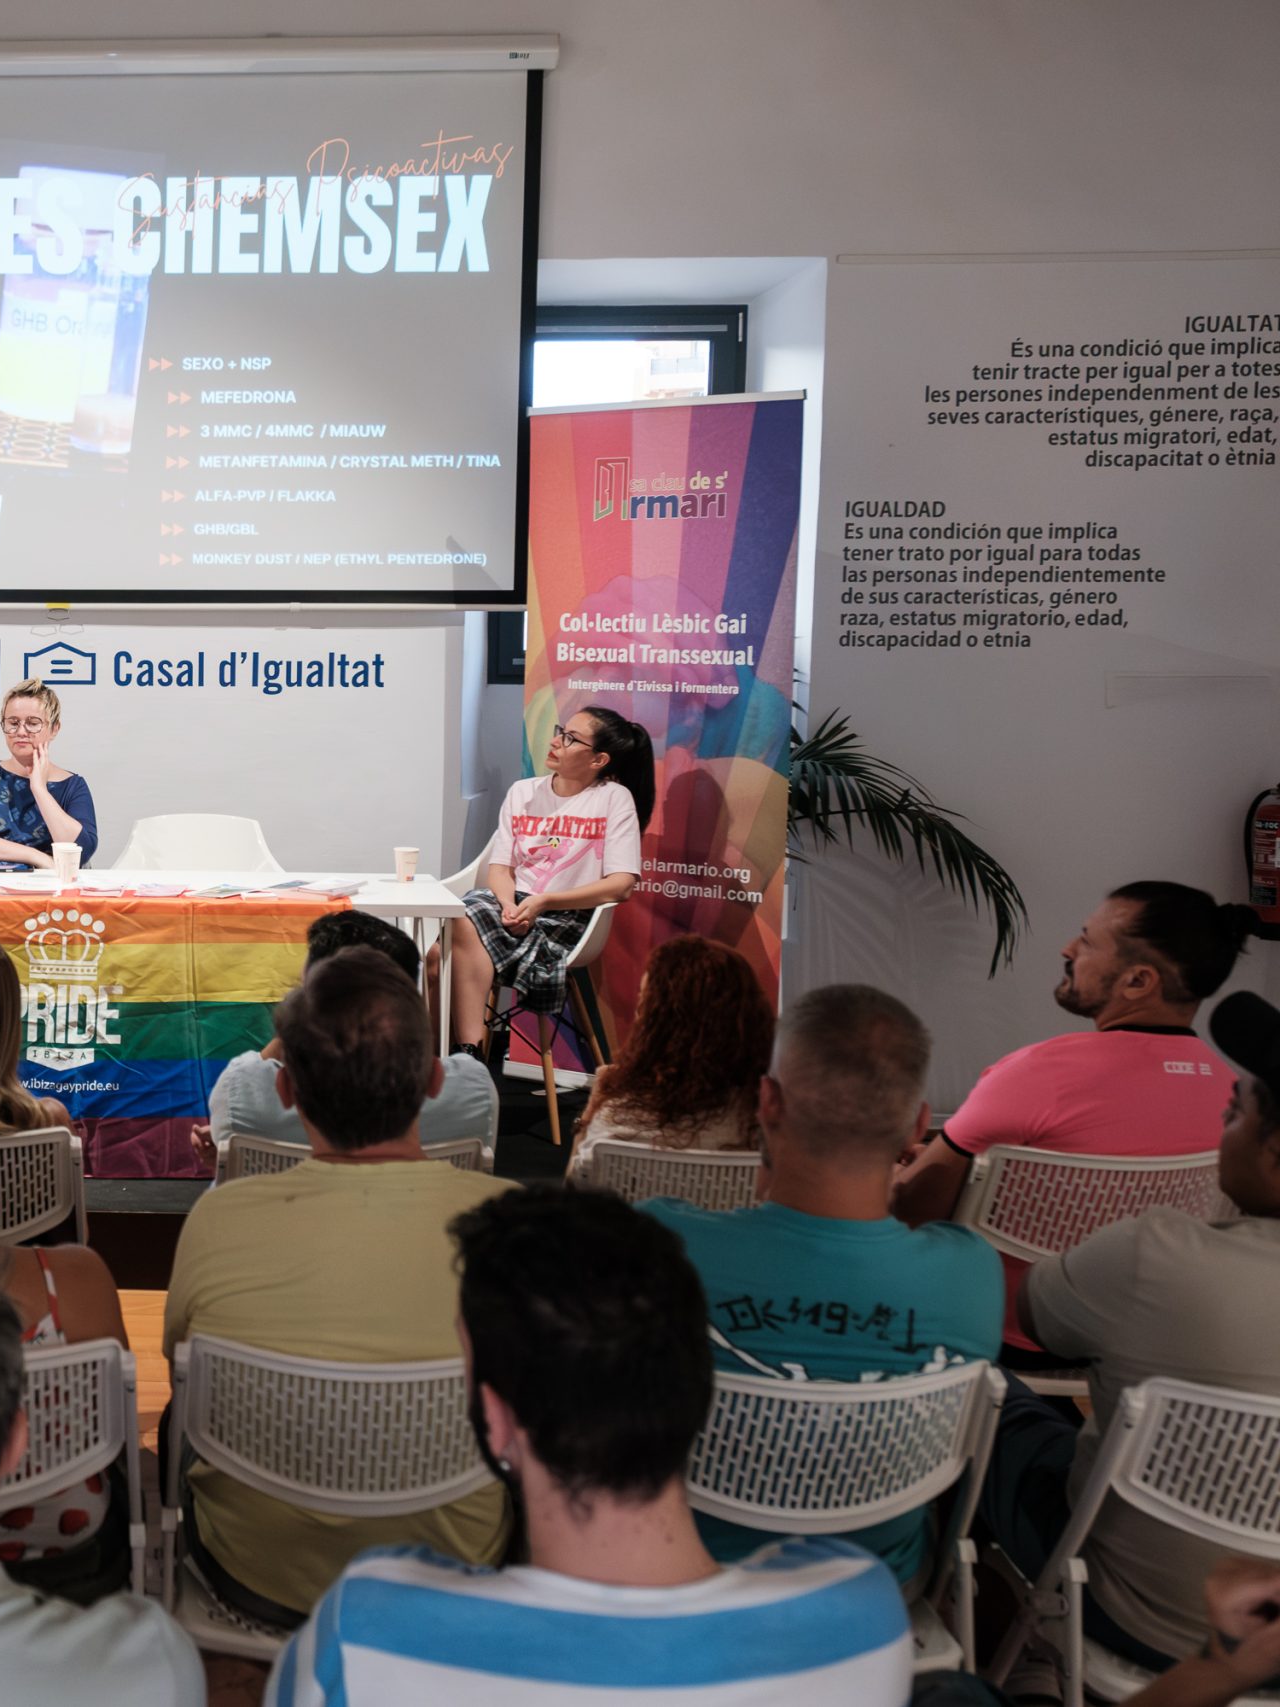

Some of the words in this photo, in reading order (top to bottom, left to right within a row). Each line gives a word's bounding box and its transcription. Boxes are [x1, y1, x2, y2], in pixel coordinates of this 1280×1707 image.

[118, 170, 296, 249] Sustancias
[306, 129, 515, 217] Psicoactivas
[116, 174, 493, 275] CHEMSEX
[11, 308, 48, 333] GHB
[1011, 338, 1033, 358] És
[1039, 345, 1075, 357] una
[1080, 339, 1163, 357] condició
[1168, 342, 1206, 360] que
[1211, 337, 1280, 358] implica
[183, 357, 223, 371] SEXO
[228, 360, 237, 370] +
[241, 357, 271, 371] NSP
[973, 363, 1019, 380] tenir
[1024, 364, 1081, 380] tracte
[1086, 365, 1119, 383] per
[1123, 361, 1171, 383] igual
[1177, 364, 1210, 382] per
[1215, 366, 1226, 378] a
[1232, 361, 1280, 378] totes
[201, 391, 296, 404] MEFEDRONA
[925, 386, 950, 403] les
[956, 388, 1043, 406] persones
[1048, 384, 1219, 405] independenment
[1223, 382, 1248, 399] de
[1254, 382, 1280, 399] les
[928, 411, 980, 425] seves
[985, 406, 1145, 428] característiques,
[1149, 405, 1224, 426] génere,
[1230, 407, 1280, 426] raça,
[200, 425, 210, 438] 3
[214, 425, 252, 438] MMC
[255, 424, 262, 439] /
[265, 425, 314, 438] 4MMC
[320, 424, 327, 439] /
[330, 425, 386, 438] MIAUW
[1048, 430, 1119, 446] estatus
[1123, 428, 1222, 449] migratori,
[1227, 426, 1277, 446] edat,
[199, 455, 327, 468] METANFETAMINA
[330, 455, 337, 469] /
[340, 455, 408, 468] CRYSTAL
[411, 455, 454, 468] METH
[456, 454, 463, 469] /
[466, 455, 501, 468] TINA
[1085, 450, 1203, 471] discapacitat
[1208, 453, 1220, 466] o
[1225, 448, 1276, 466] ètnia
[689, 471, 711, 489] de
[195, 490, 266, 502] ALFA-PVP
[269, 490, 275, 503] /
[277, 490, 336, 502] FLAKKA
[845, 501, 946, 518] IGUALDAD
[194, 523, 259, 536] GHB/GBL
[844, 523, 864, 539] Es
[869, 528, 903, 539] una
[909, 522, 1001, 540] condición
[1006, 526, 1043, 543] que
[1048, 522, 1118, 543] implica
[192, 553, 252, 565] MONKEY
[255, 553, 292, 565] DUST
[295, 553, 300, 566] /
[304, 553, 332, 565] NEP
[335, 553, 384, 567] (ETHYL
[388, 553, 487, 567] PENTEDRONE)
[843, 546, 893, 561] tener
[898, 546, 944, 561] trato
[949, 547, 982, 565] por
[987, 544, 1034, 565] igual
[1039, 547, 1082, 565] para
[1088, 544, 1141, 561] todas
[842, 566, 867, 583] las
[873, 569, 957, 586] personas
[963, 565, 1166, 586] independientemente
[841, 587, 864, 604] de
[869, 592, 899, 604] sus
[903, 588, 1044, 607] características,
[1050, 587, 1118, 608] género
[653, 613, 710, 634] Lèsbic
[714, 614, 747, 634] Gai
[840, 614, 884, 628] raza,
[889, 611, 957, 626] estatus
[963, 609, 1071, 630] migratorio,
[1075, 609, 1128, 628] edad,
[839, 631, 961, 651] discapacidad
[966, 635, 978, 647] o
[983, 631, 1031, 647] etnia
[557, 643, 635, 663] Bisexual
[640, 644, 754, 666] Transsexual
[113, 650, 206, 687] Casal
[218, 650, 385, 695] d'Igualtat
[675, 681, 679, 692] i
[681, 682, 739, 695] Formentera
